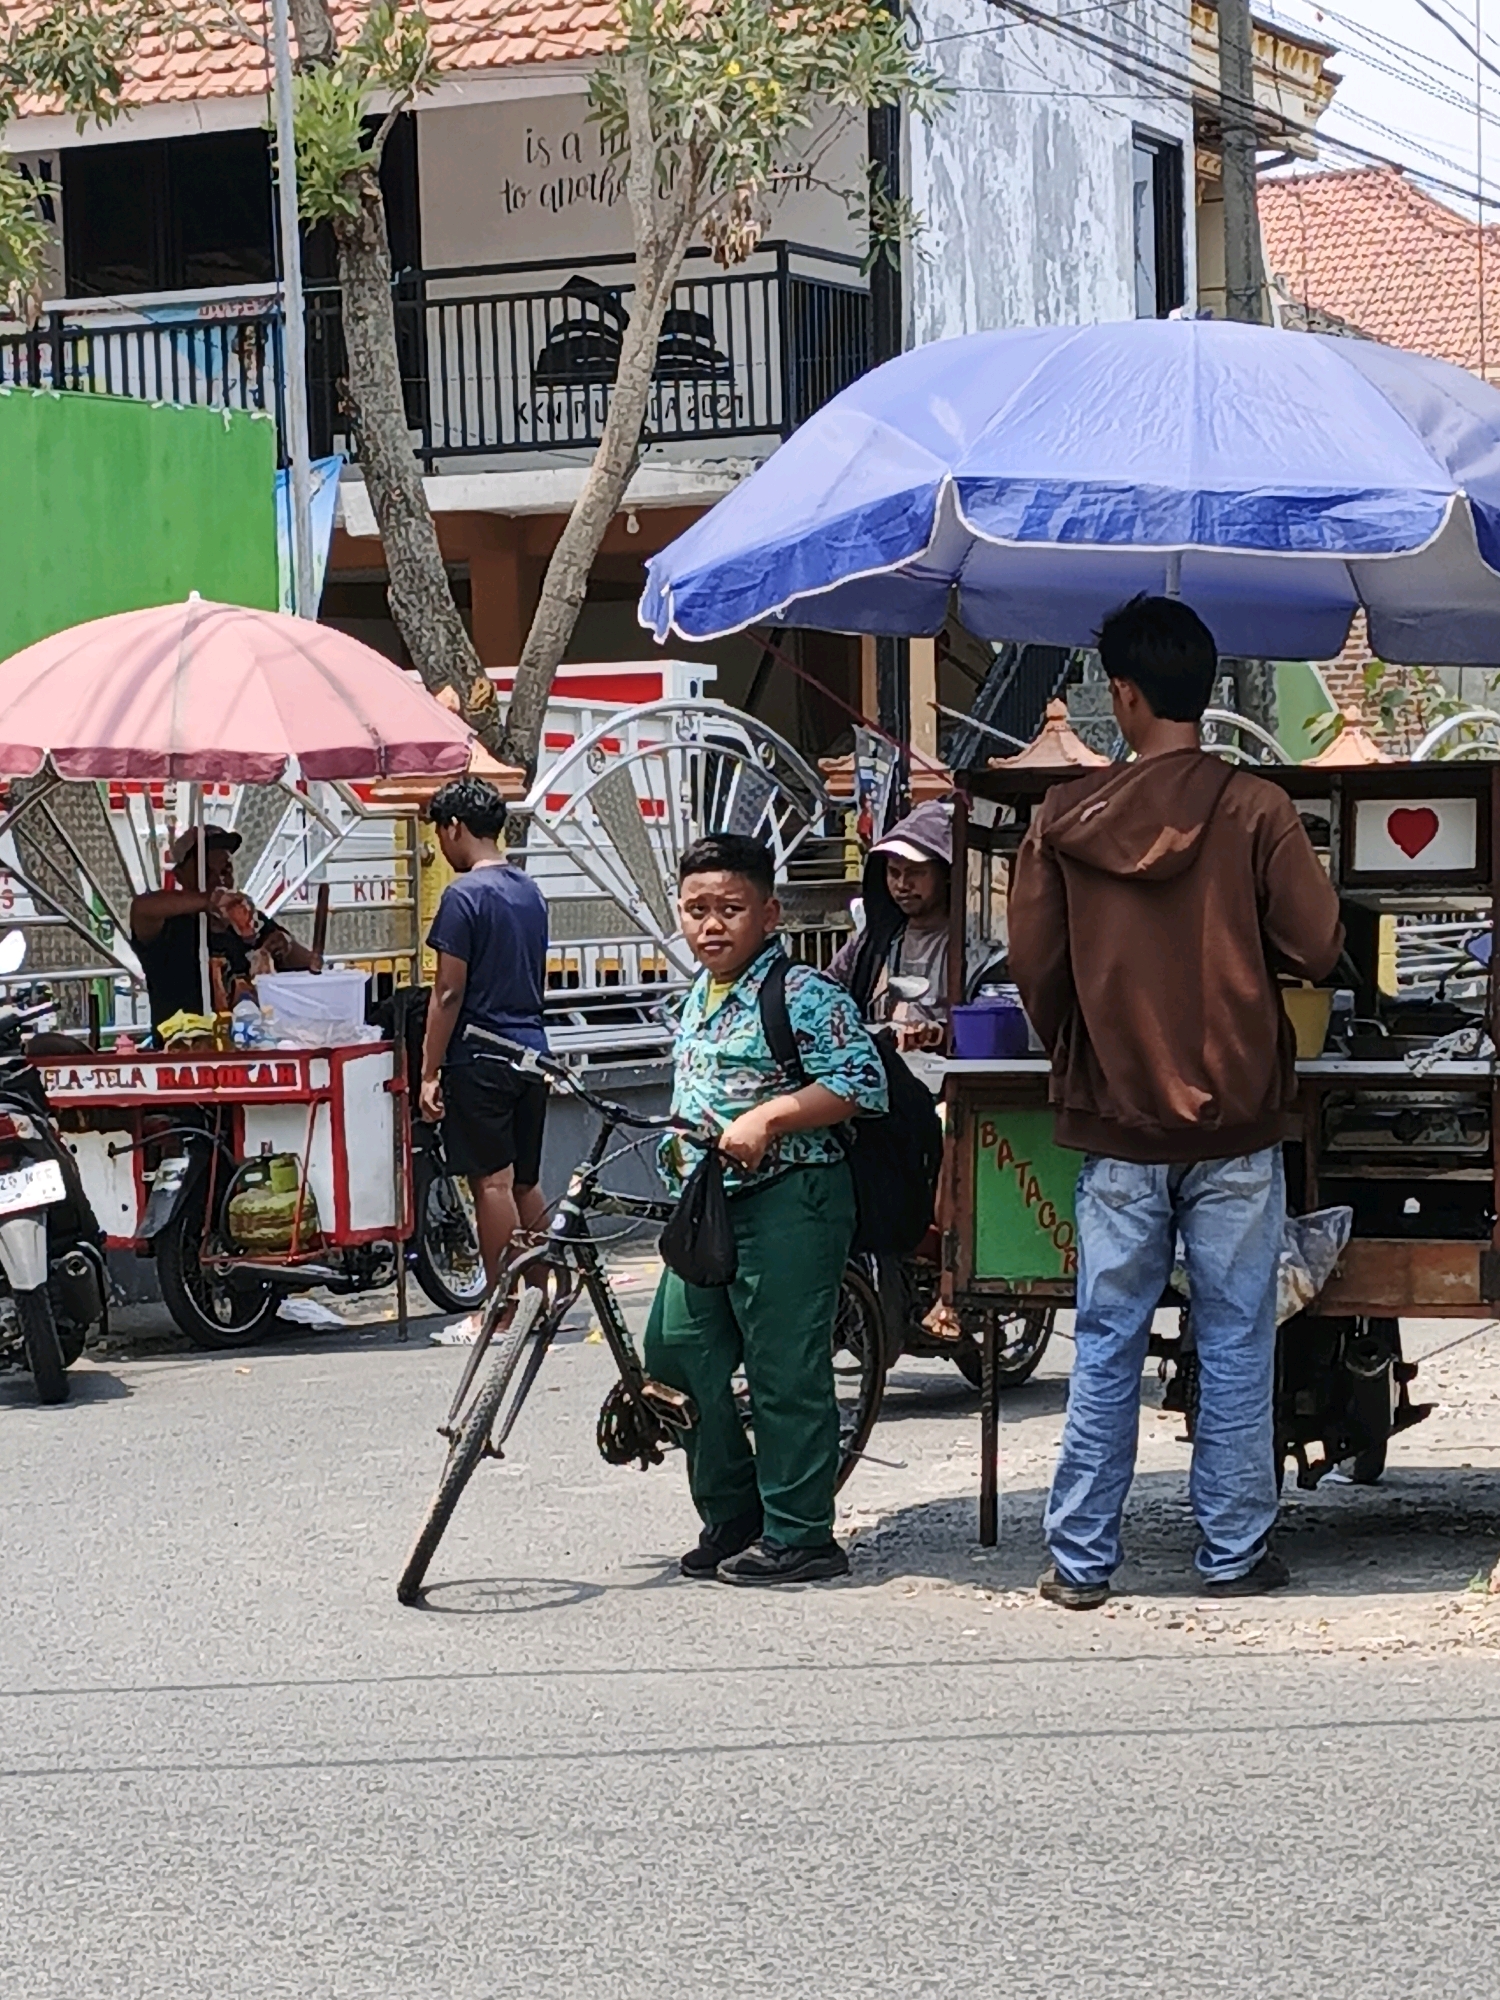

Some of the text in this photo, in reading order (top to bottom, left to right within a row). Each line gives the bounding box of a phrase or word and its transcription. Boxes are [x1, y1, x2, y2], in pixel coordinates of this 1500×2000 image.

[525, 127, 551, 169] is
[561, 131, 582, 164] a
[499, 177, 533, 214] to
[156, 1063, 298, 1090] BAROKAH
[980, 1120, 1080, 1274] BATAGOR
